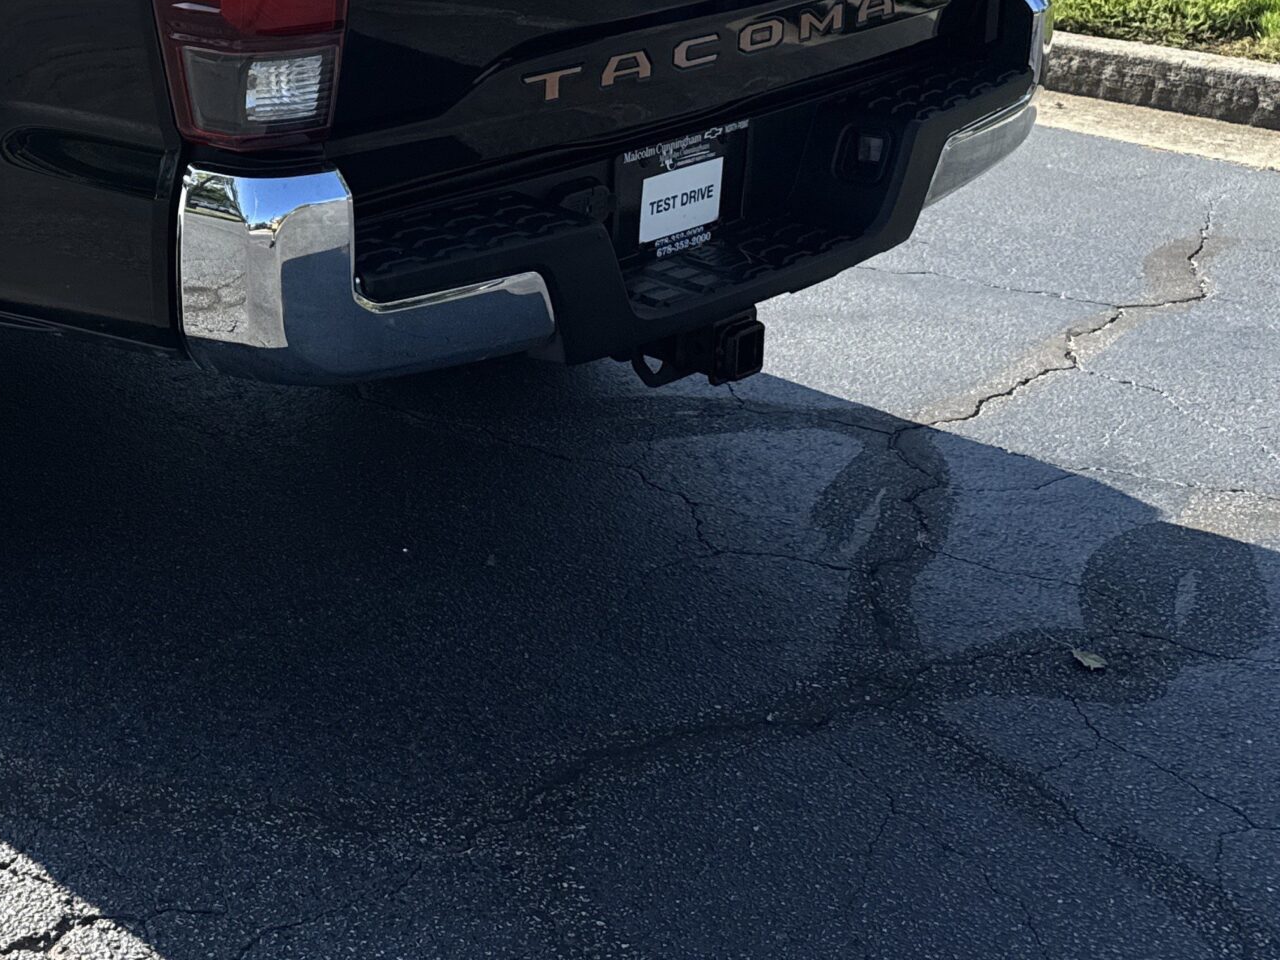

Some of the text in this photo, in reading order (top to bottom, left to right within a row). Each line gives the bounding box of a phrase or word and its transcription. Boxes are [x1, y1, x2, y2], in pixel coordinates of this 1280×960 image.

[624, 148, 656, 164] Malcolm
[656, 135, 702, 155] Cunningham
[649, 184, 714, 215] TEST DRIVE
